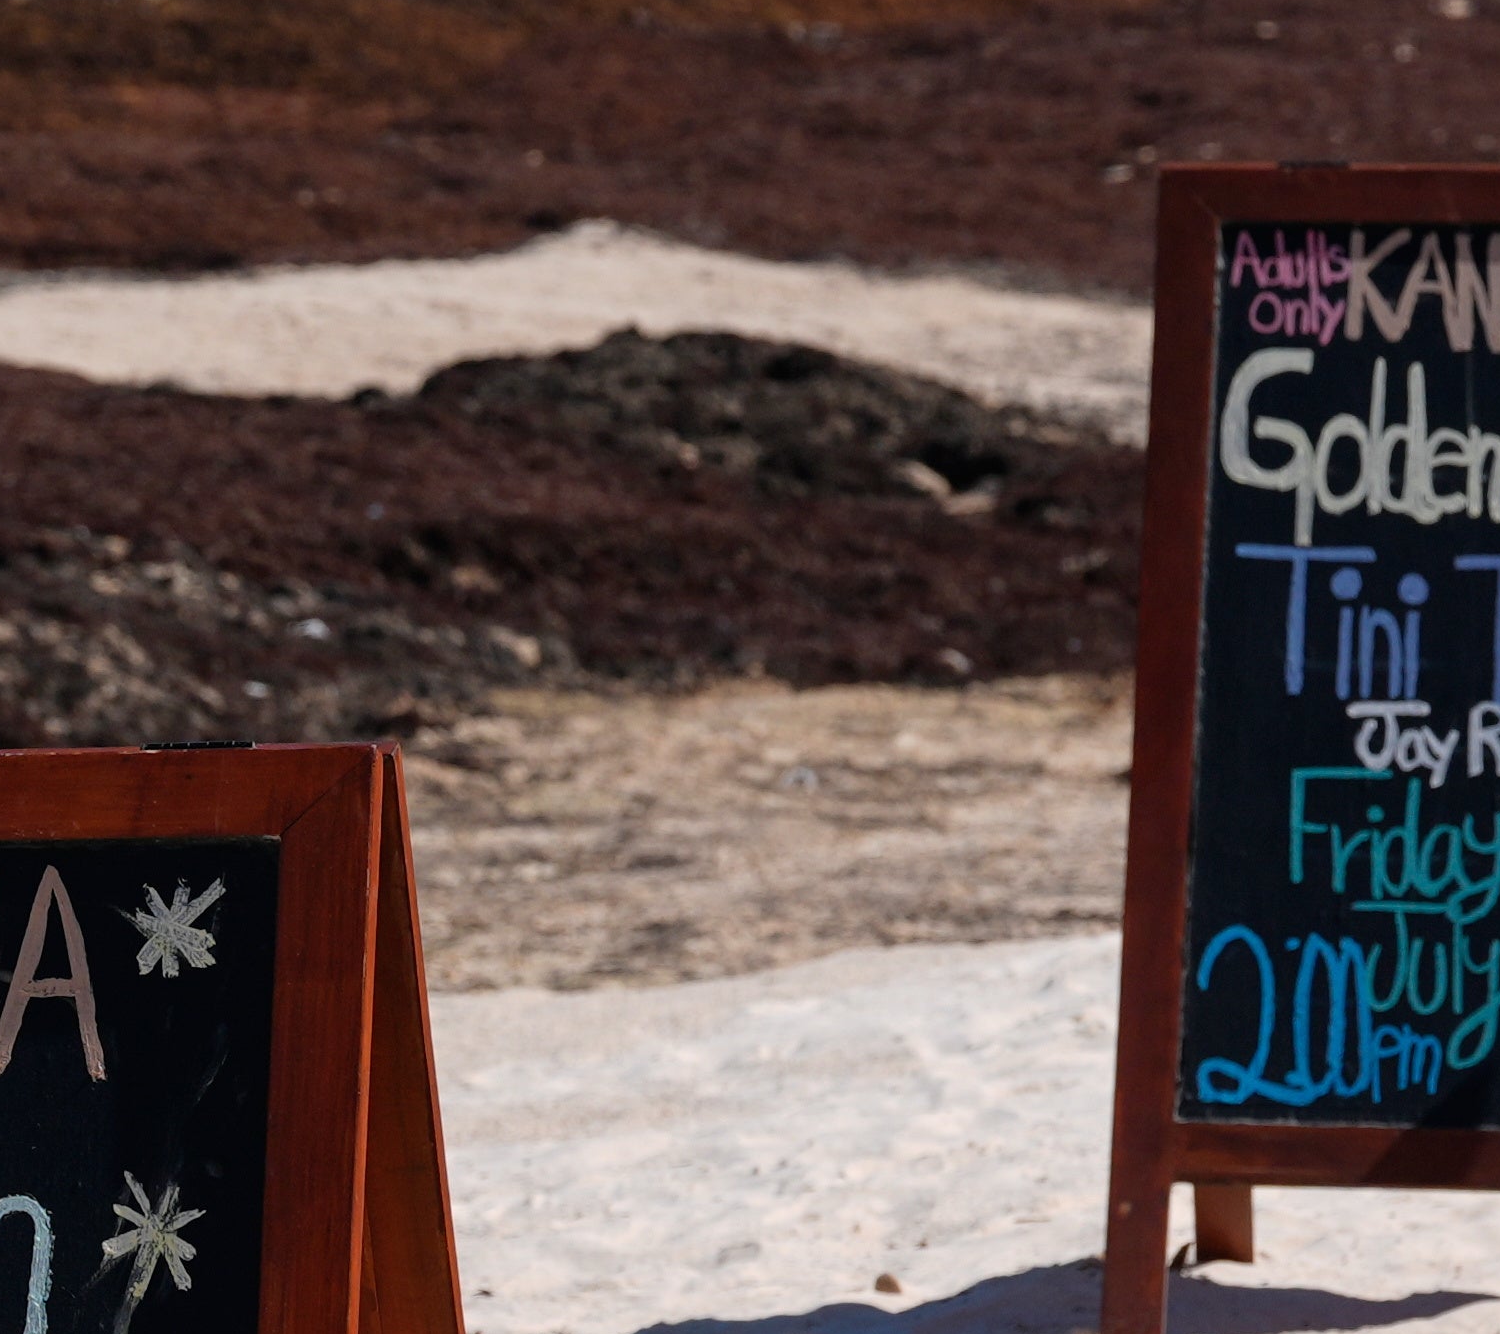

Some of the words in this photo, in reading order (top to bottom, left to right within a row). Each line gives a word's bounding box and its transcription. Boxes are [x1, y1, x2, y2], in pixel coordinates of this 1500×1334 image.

[1248, 289, 1346, 346] Only
[1235, 542, 1430, 700] Tini
[1346, 700, 1461, 789] Jay
